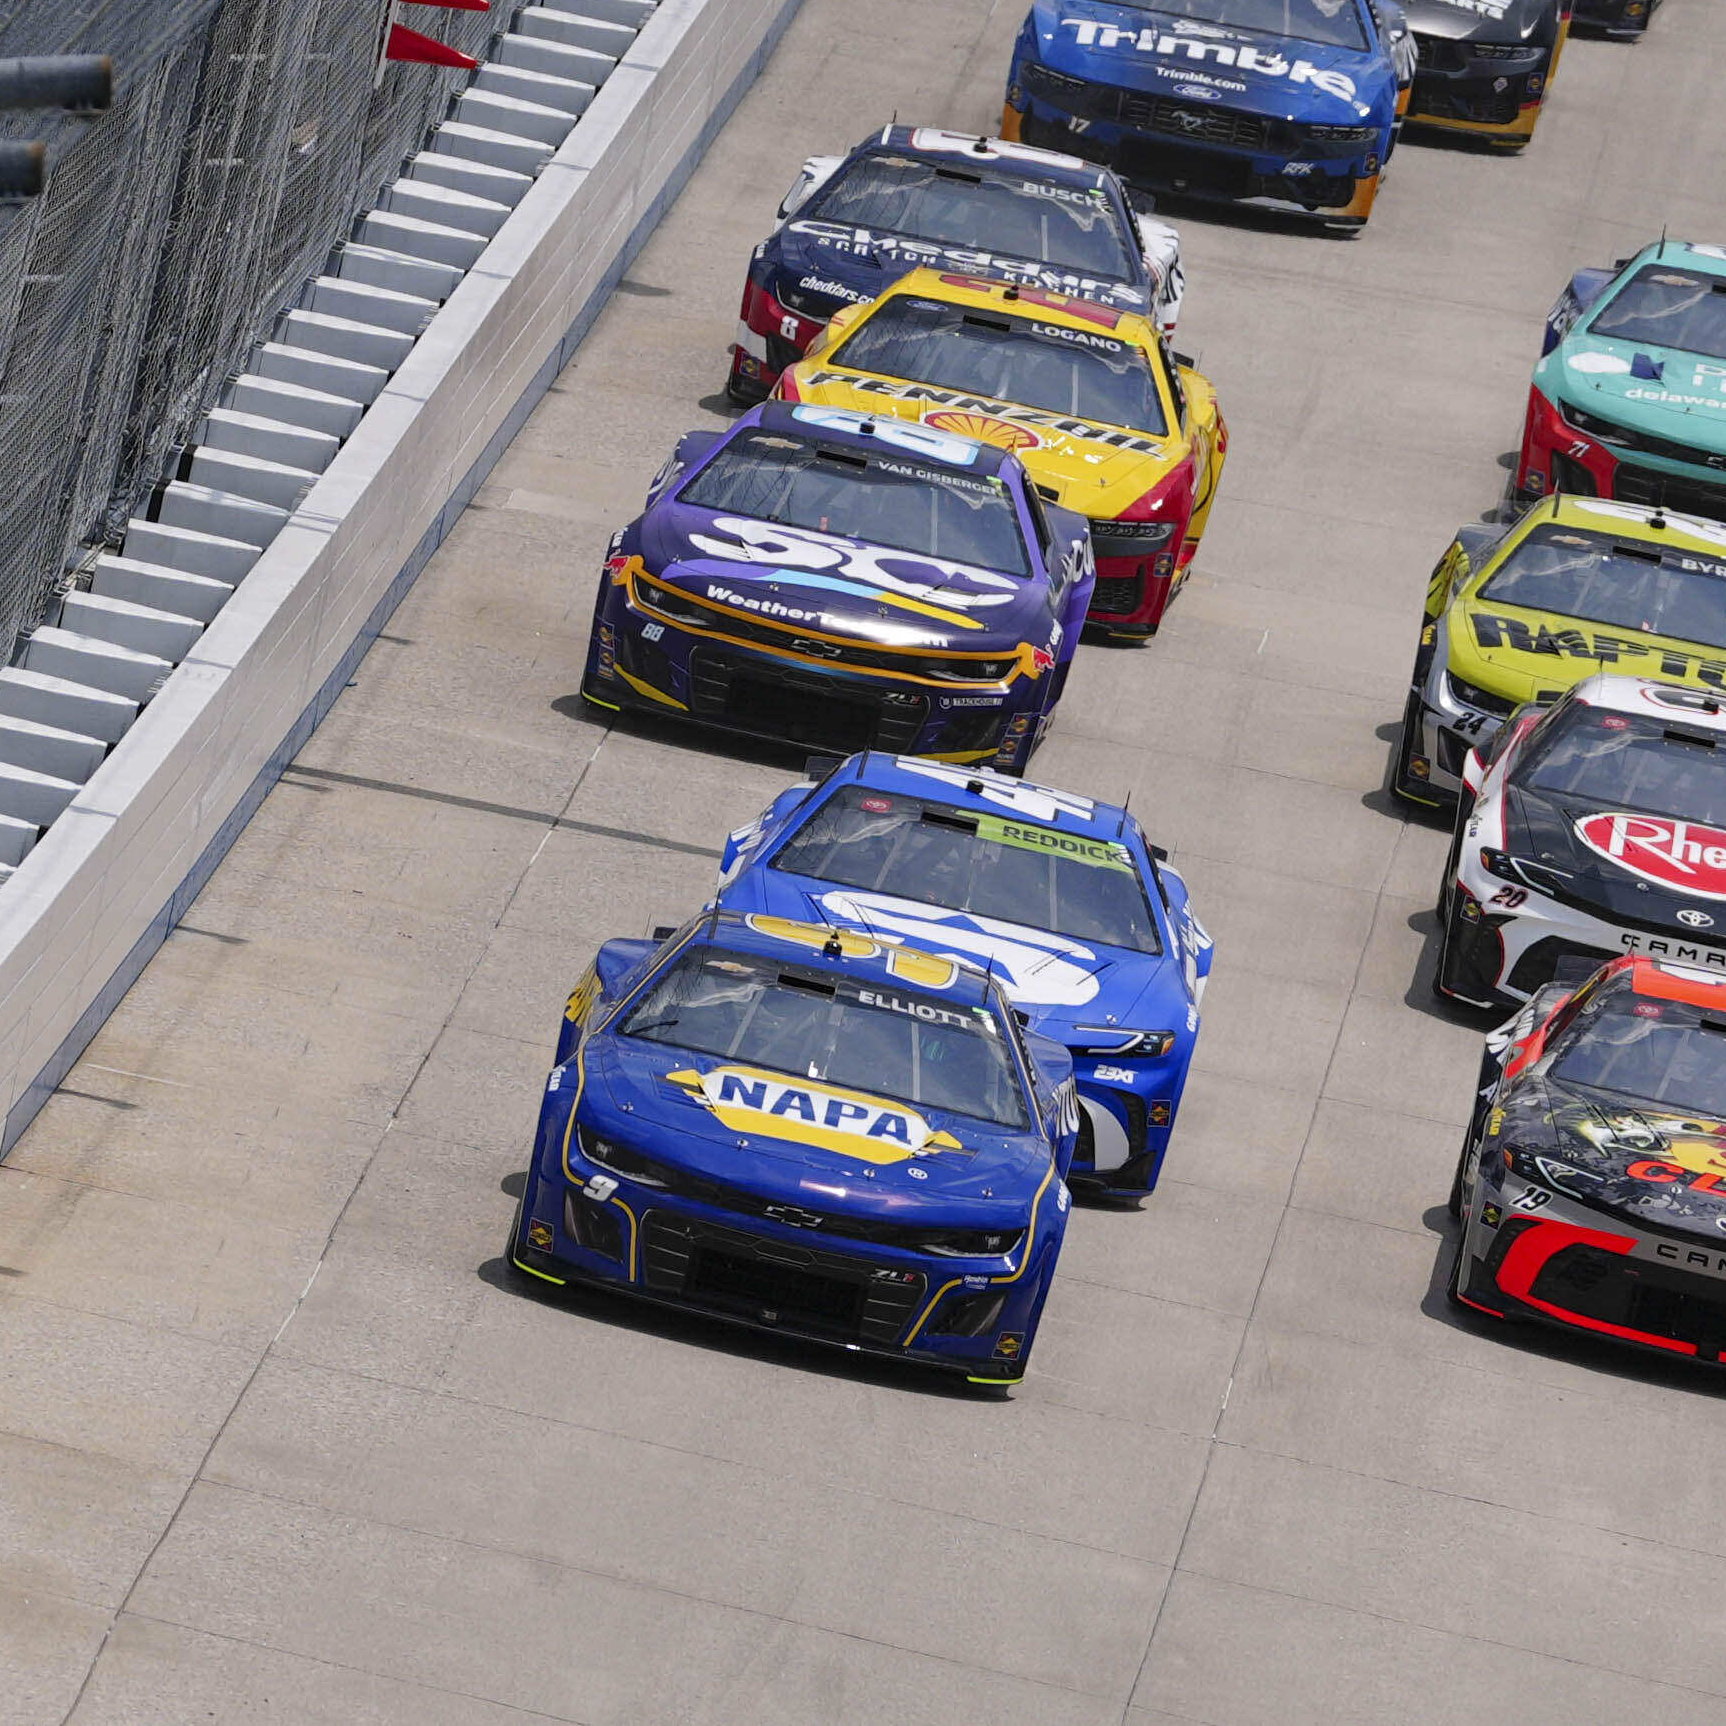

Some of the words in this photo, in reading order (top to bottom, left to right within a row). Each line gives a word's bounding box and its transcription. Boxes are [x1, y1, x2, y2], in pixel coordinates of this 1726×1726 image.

[1060, 17, 1357, 103] Trimble
[1154, 65, 1247, 92] Trimble.com
[1068, 116, 1091, 133] 17
[1022, 180, 1101, 207] BUSCH
[817, 236, 937, 265] SCRATCH
[798, 275, 876, 306] cheddars.co
[779, 316, 800, 341] 8
[1030, 322, 1122, 353] LOGANO
[802, 371, 1170, 462] PENNZOIL
[1567, 440, 1591, 458] 71
[876, 461, 916, 477] VAN
[917, 467, 1004, 496] GISBERGEN
[641, 623, 665, 643] 88
[1452, 712, 1483, 734] 24
[1002, 824, 1122, 864] REDDICK
[1488, 886, 1528, 909] 20
[858, 990, 973, 1029] ELLIOTT
[718, 1074, 913, 1146] NAPA
[582, 1174, 620, 1202] 9
[1508, 1185, 1554, 1212] 19
